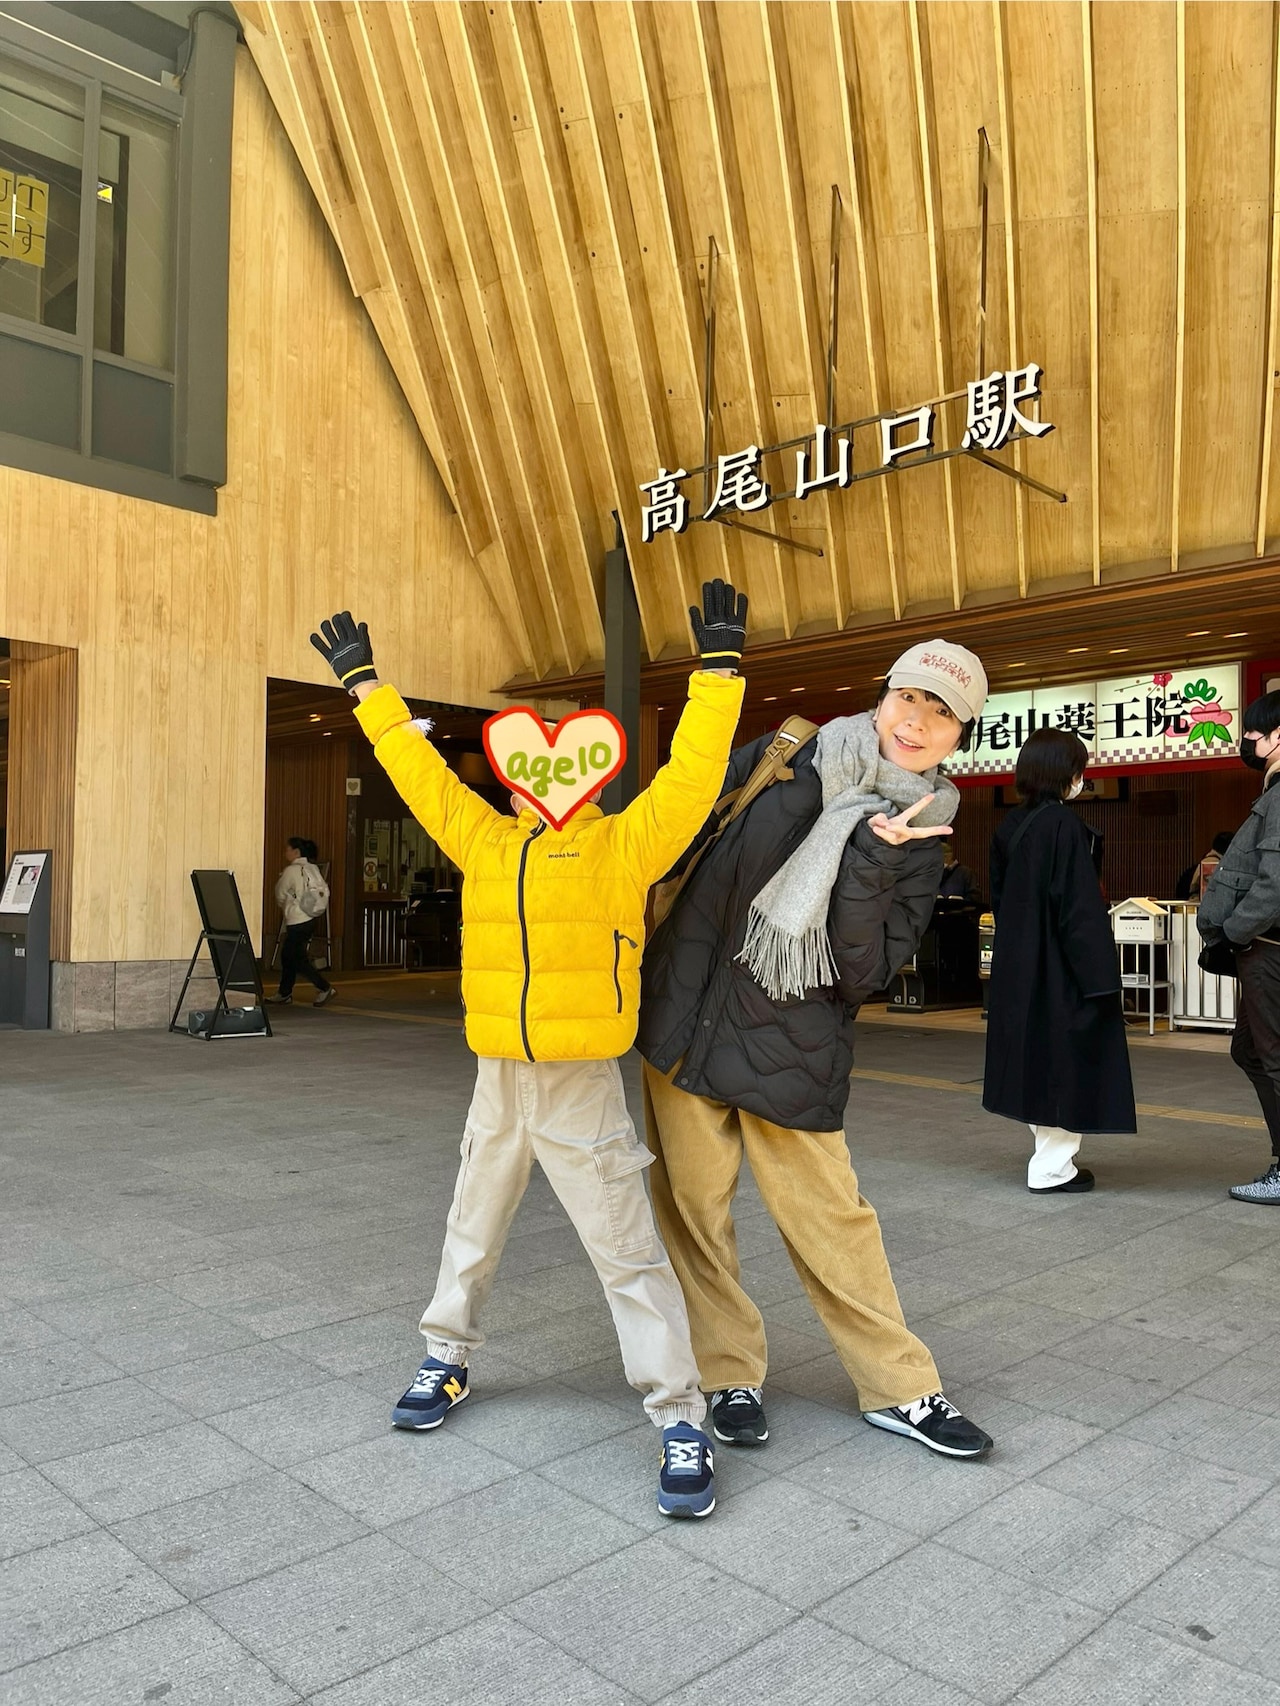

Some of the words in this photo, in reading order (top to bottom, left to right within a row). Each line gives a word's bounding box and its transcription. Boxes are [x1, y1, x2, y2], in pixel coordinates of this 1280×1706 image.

[639, 362, 1054, 542] 高尾山口駅
[975, 689, 1191, 753] 尾山薬王院
